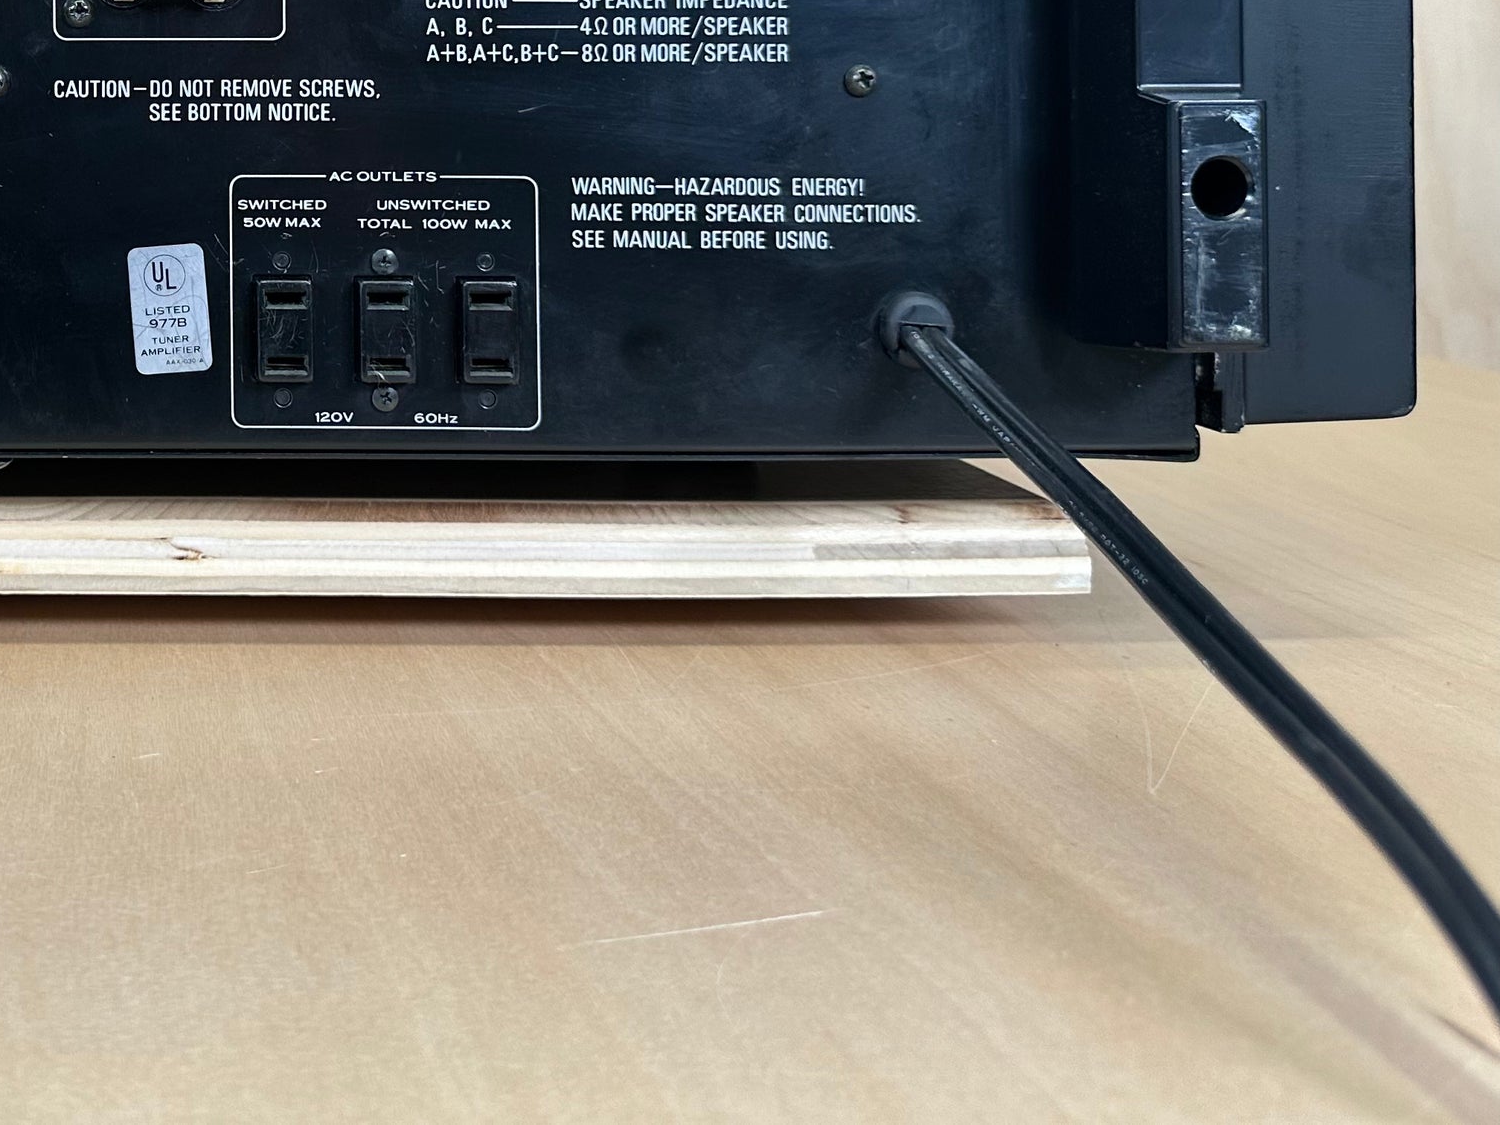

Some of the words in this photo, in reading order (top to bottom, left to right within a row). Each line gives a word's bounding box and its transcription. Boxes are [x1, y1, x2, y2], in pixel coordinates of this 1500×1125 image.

[426, 18, 444, 37] A,
[456, 18, 472, 37] B,
[613, 17, 636, 35] OR
[641, 16, 788, 38] MORE/SPEAKER
[613, 44, 635, 62] OR
[641, 42, 788, 65] MORE/SPEAKER
[180, 79, 214, 97] NOT
[221, 79, 292, 97] REMOVE
[299, 79, 380, 99] SCREWS,
[150, 103, 181, 121] SEE
[188, 103, 260, 121] BOTTOM
[269, 103, 335, 121] NOTICE.
[329, 171, 352, 181] AC
[357, 171, 437, 182] OUTLETS
[792, 178, 863, 196] ENERGY!
[238, 200, 327, 210] SWITCHED
[377, 200, 490, 210] UNSWITCHED
[572, 203, 622, 221] MAKE
[632, 203, 696, 221] PROPER
[705, 204, 785, 222] SPEAKER
[795, 204, 921, 222] CONNECTIONS.
[244, 217, 281, 227] 50W
[286, 218, 321, 227] MAX
[357, 219, 412, 229] TOTAL
[423, 219, 467, 229] 100W
[475, 219, 511, 229] MAX
[572, 230, 604, 248] SEE
[613, 230, 692, 249] MANUAL
[701, 231, 766, 249] BEFORE
[776, 231, 833, 249] USING.
[145, 305, 190, 316] LISTED
[150, 318, 187, 328] 977B
[152, 336, 189, 344] TUNER
[141, 346, 200, 356] AMPLIFIER
[315, 412, 353, 422] 120V
[414, 413, 458, 423] 60Hz
